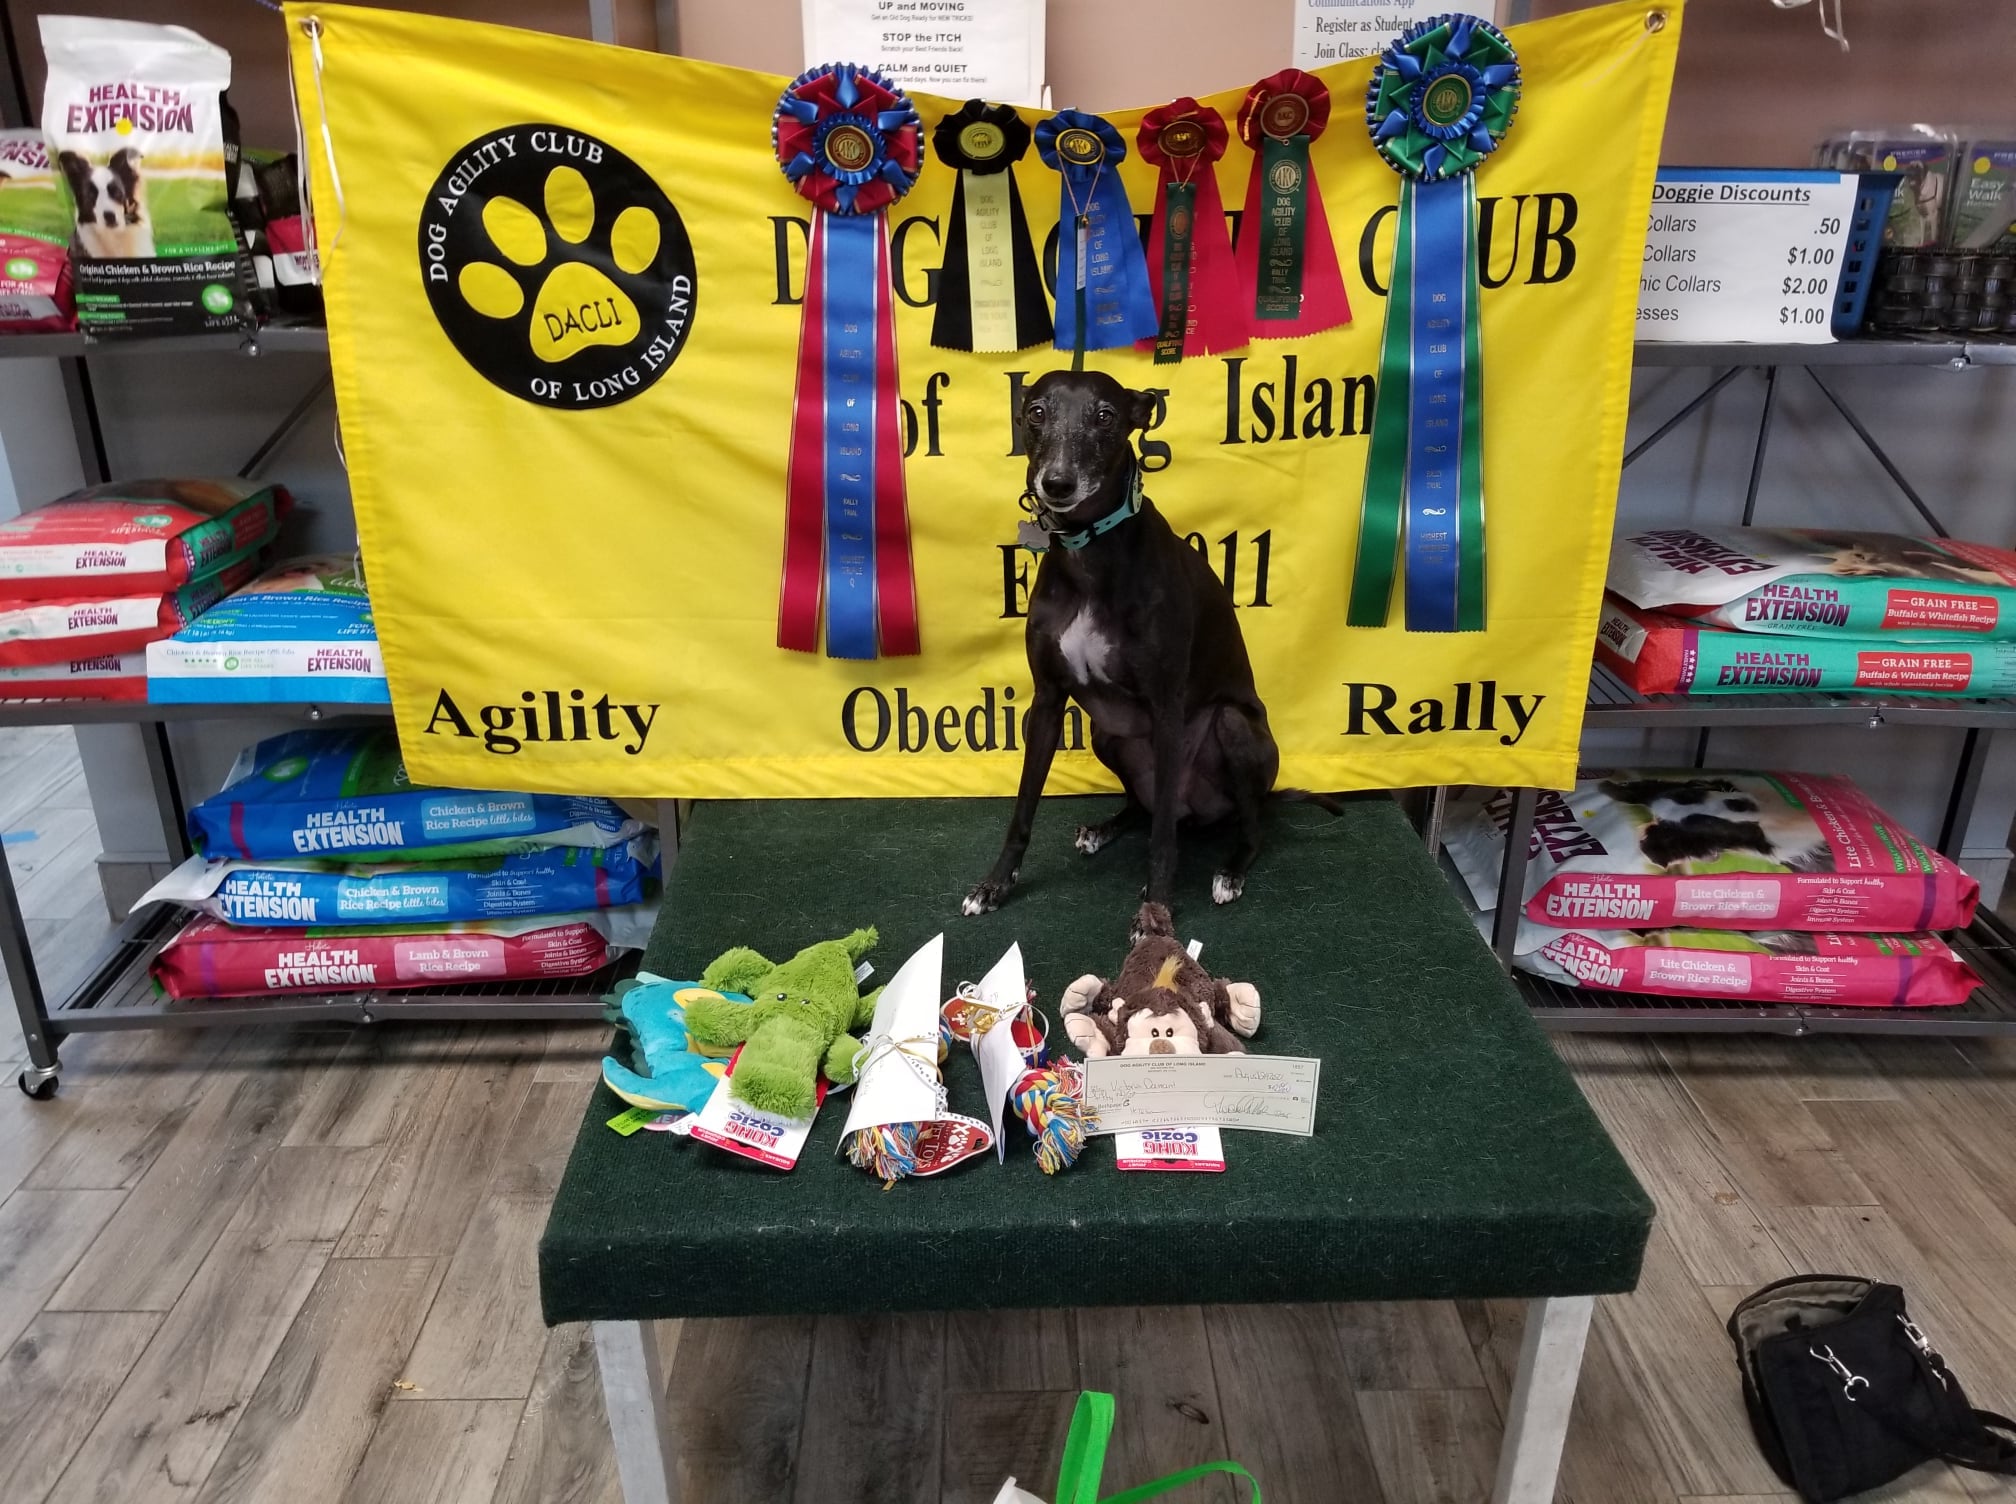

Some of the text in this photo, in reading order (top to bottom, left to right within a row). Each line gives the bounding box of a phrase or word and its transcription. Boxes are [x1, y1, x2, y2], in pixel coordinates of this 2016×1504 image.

[878, 2, 965, 11] UP and MOVING
[1308, 0, 1391, 8] Communications
[1315, 15, 1413, 35] Register as Student
[882, 33, 961, 42] STOP the ITCH
[1314, 43, 1336, 59] Join
[1338, 42, 1368, 58] Class:
[878, 64, 968, 73] CALM and QUIET
[88, 82, 182, 107] HEALTH
[66, 104, 195, 135] EXTENSION
[1276, 196, 1291, 206] DOG
[1653, 184, 1811, 203] Doggie Discounts
[427, 131, 604, 283] DOG AGILITY CLUB
[1271, 206, 1296, 217] AGILITY
[1274, 217, 1292, 226] CLUB
[1813, 218, 1841, 235] .50
[1278, 227, 1288, 236] OF
[1358, 192, 1579, 297] CUB
[1643, 244, 1834, 265] Collars $1.00
[79, 263, 104, 275] Original
[105, 262, 140, 276] Chicken
[150, 262, 182, 274] Brown
[183, 260, 204, 274] Rice
[204, 258, 236, 274] Recipe
[1666, 274, 1721, 293] Collars
[1782, 277, 1828, 295] $2.00
[1432, 293, 1447, 303] DOG
[543, 297, 622, 343] DACLI
[1635, 306, 1825, 325] esses $1.00
[530, 273, 692, 402] OF LONG ISLAND
[1429, 343, 1448, 354] CLUB
[846, 398, 856, 409] OF
[1220, 355, 1377, 446] Islan
[83, 550, 124, 558] HEALTH
[75, 557, 127, 570] EXTENSION
[1762, 584, 1839, 602] HEALTH
[73, 607, 113, 617] HEALTH
[1745, 597, 1850, 627] EXTENSION
[1910, 597, 1978, 611] GRAIN FREE
[68, 614, 119, 631] EXTENSION
[1887, 608, 1996, 625] Buffalo & Whitefish Recipe
[1602, 621, 1628, 648] EXTENSION
[317, 649, 363, 658] HEALTH
[1736, 651, 1810, 666] HEALTH
[70, 655, 122, 674] EXTENSION
[307, 656, 374, 674] EXTENSION
[1881, 658, 1952, 668] GRAIN FREE
[1717, 665, 1823, 688] EXTENSION
[1859, 670, 1890, 680] Buffalo
[1900, 671, 1941, 680] Whitefish
[1942, 672, 1970, 682] Recipe
[423, 680, 1546, 756] Agility Obedin Rally
[429, 800, 525, 817] Chicken & Brown
[306, 807, 385, 829] HEALTH
[425, 819, 450, 831] Rice
[452, 816, 489, 830] Recipe
[292, 821, 405, 853] EXTENSION
[225, 880, 302, 897] HEALTH
[346, 885, 439, 898] Chicken & Brown
[1563, 883, 1641, 898] HEALTH
[1690, 888, 1765, 899] Lite Chicken &
[340, 899, 364, 911] Rice
[366, 899, 401, 912] Recipe
[1546, 893, 1658, 921] EXTENSION
[1680, 901, 1776, 914] Brown Rice Recipe
[521, 930, 557, 943] Formulated
[564, 926, 589, 938] Support
[278, 949, 359, 968] HEALTH
[409, 948, 489, 962] Lamb & Brown
[419, 960, 481, 975] Rice Recipe
[1542, 947, 1628, 989] TENSION
[1660, 958, 1736, 973] Lite Chicken &
[264, 963, 377, 989] EXTENSION
[1650, 970, 1748, 987] Brown Rice Recipe
[1784, 986, 1837, 995] Digestive System
[729, 1111, 785, 1137] Cozie
[931, 1121, 947, 1141] PET
[724, 1119, 779, 1150] KONG
[1141, 1131, 1199, 1143] Cozie
[1142, 1141, 1200, 1156] KONG
